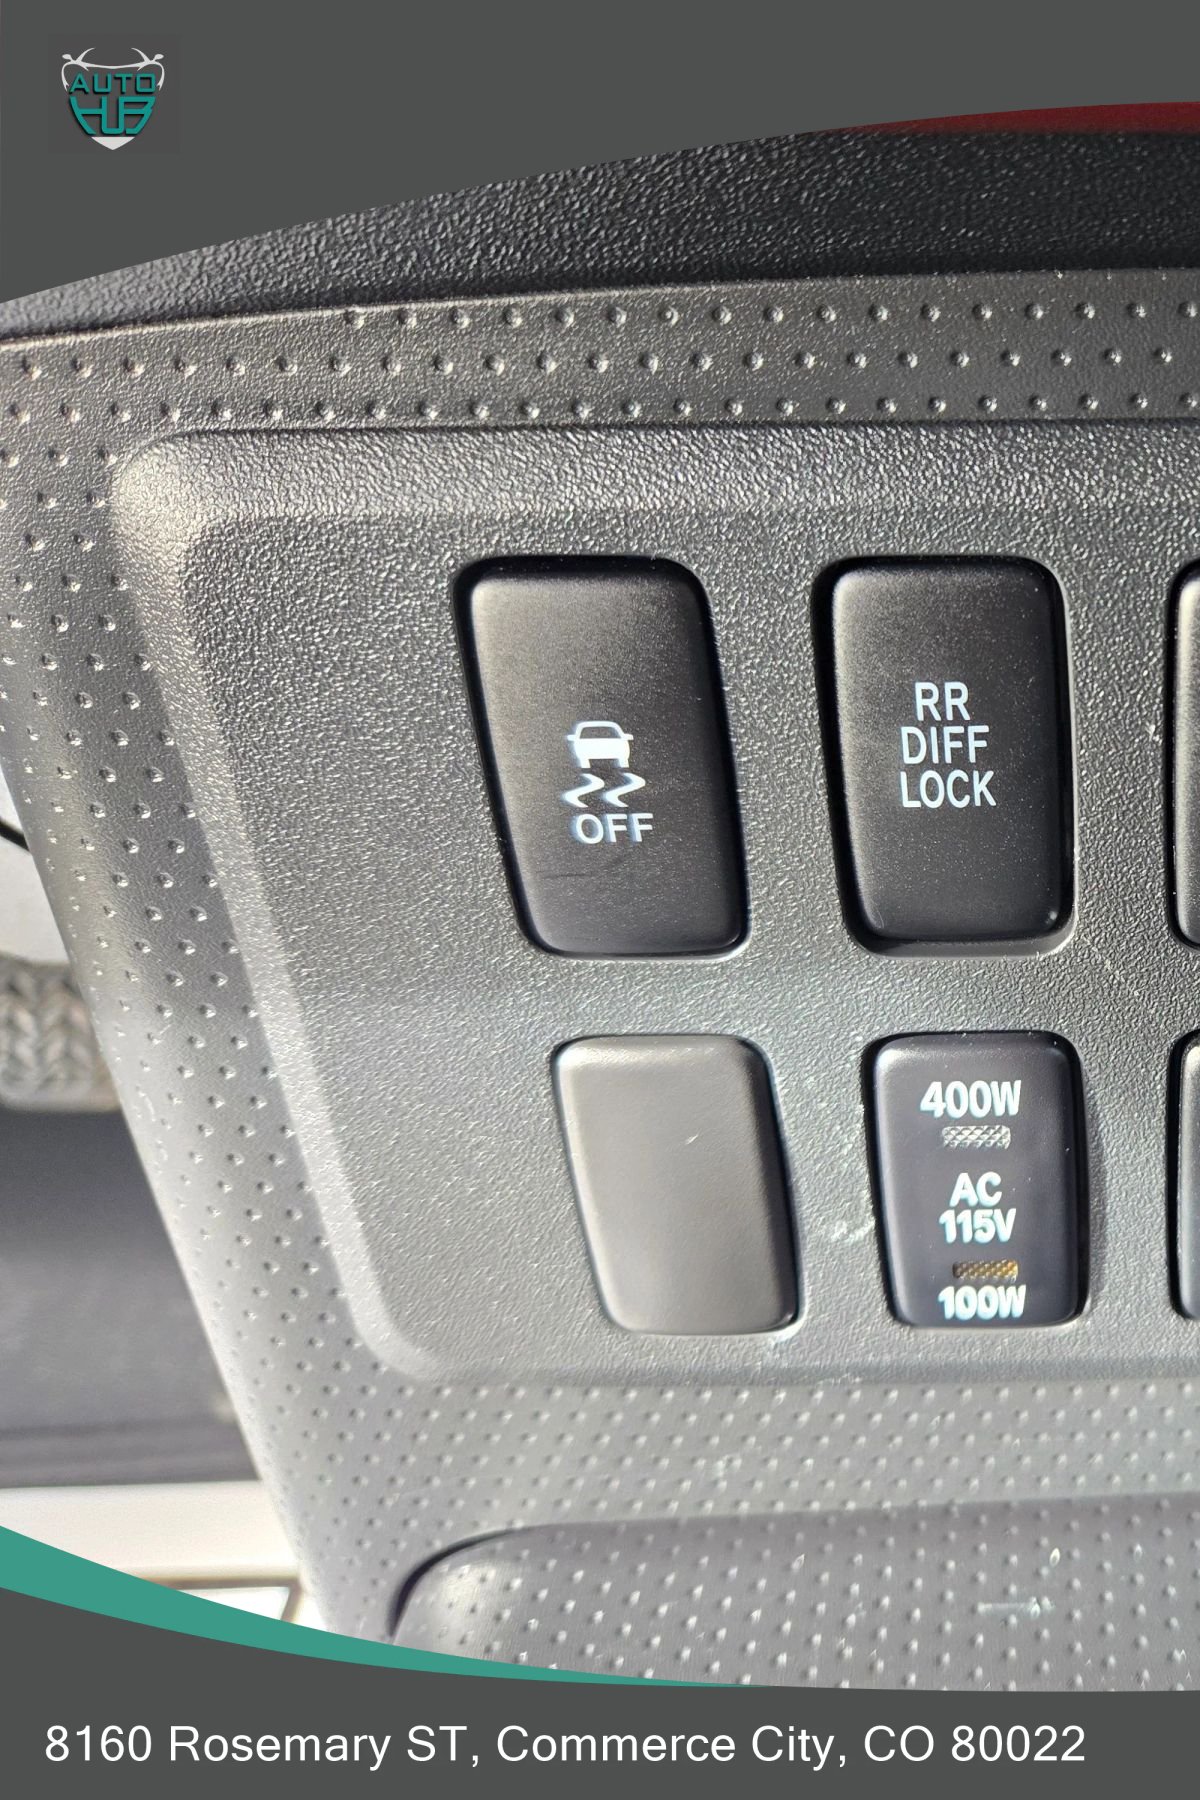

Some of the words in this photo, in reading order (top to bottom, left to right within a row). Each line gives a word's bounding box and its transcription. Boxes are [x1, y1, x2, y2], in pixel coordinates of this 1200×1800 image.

[914, 681, 971, 721] RR
[901, 724, 989, 764] DIFF
[901, 769, 997, 808] LOCK
[570, 812, 654, 845] OFF
[919, 1079, 1022, 1119] 400W
[948, 1171, 1003, 1208] AC
[938, 1207, 1017, 1244] 115V
[937, 1284, 1027, 1321] 100W
